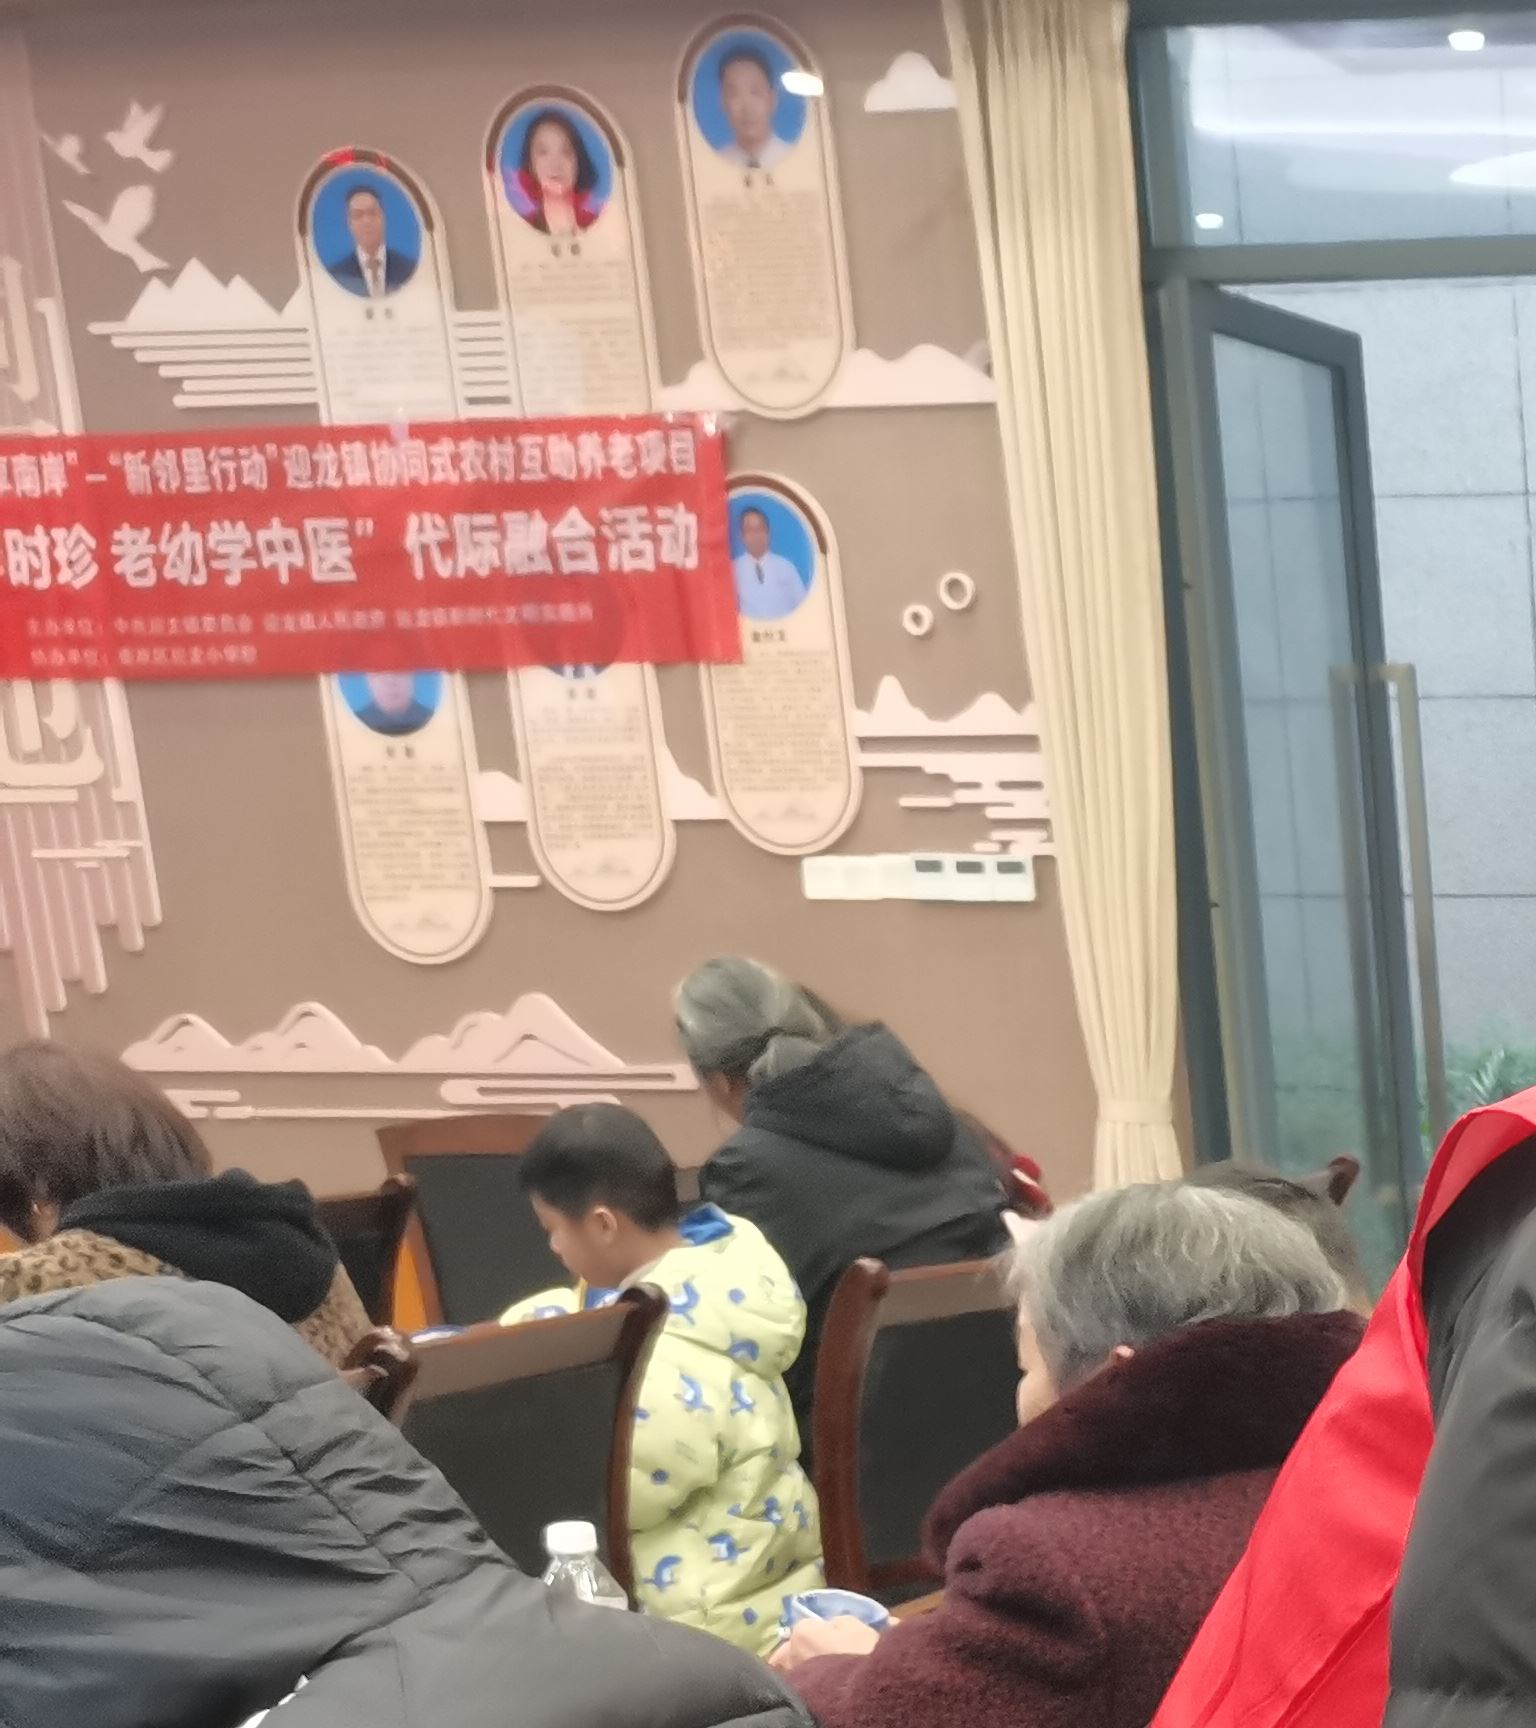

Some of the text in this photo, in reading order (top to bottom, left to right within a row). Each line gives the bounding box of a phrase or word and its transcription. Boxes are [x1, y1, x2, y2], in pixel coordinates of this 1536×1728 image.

[404, 501, 698, 581] 代际融合活动
